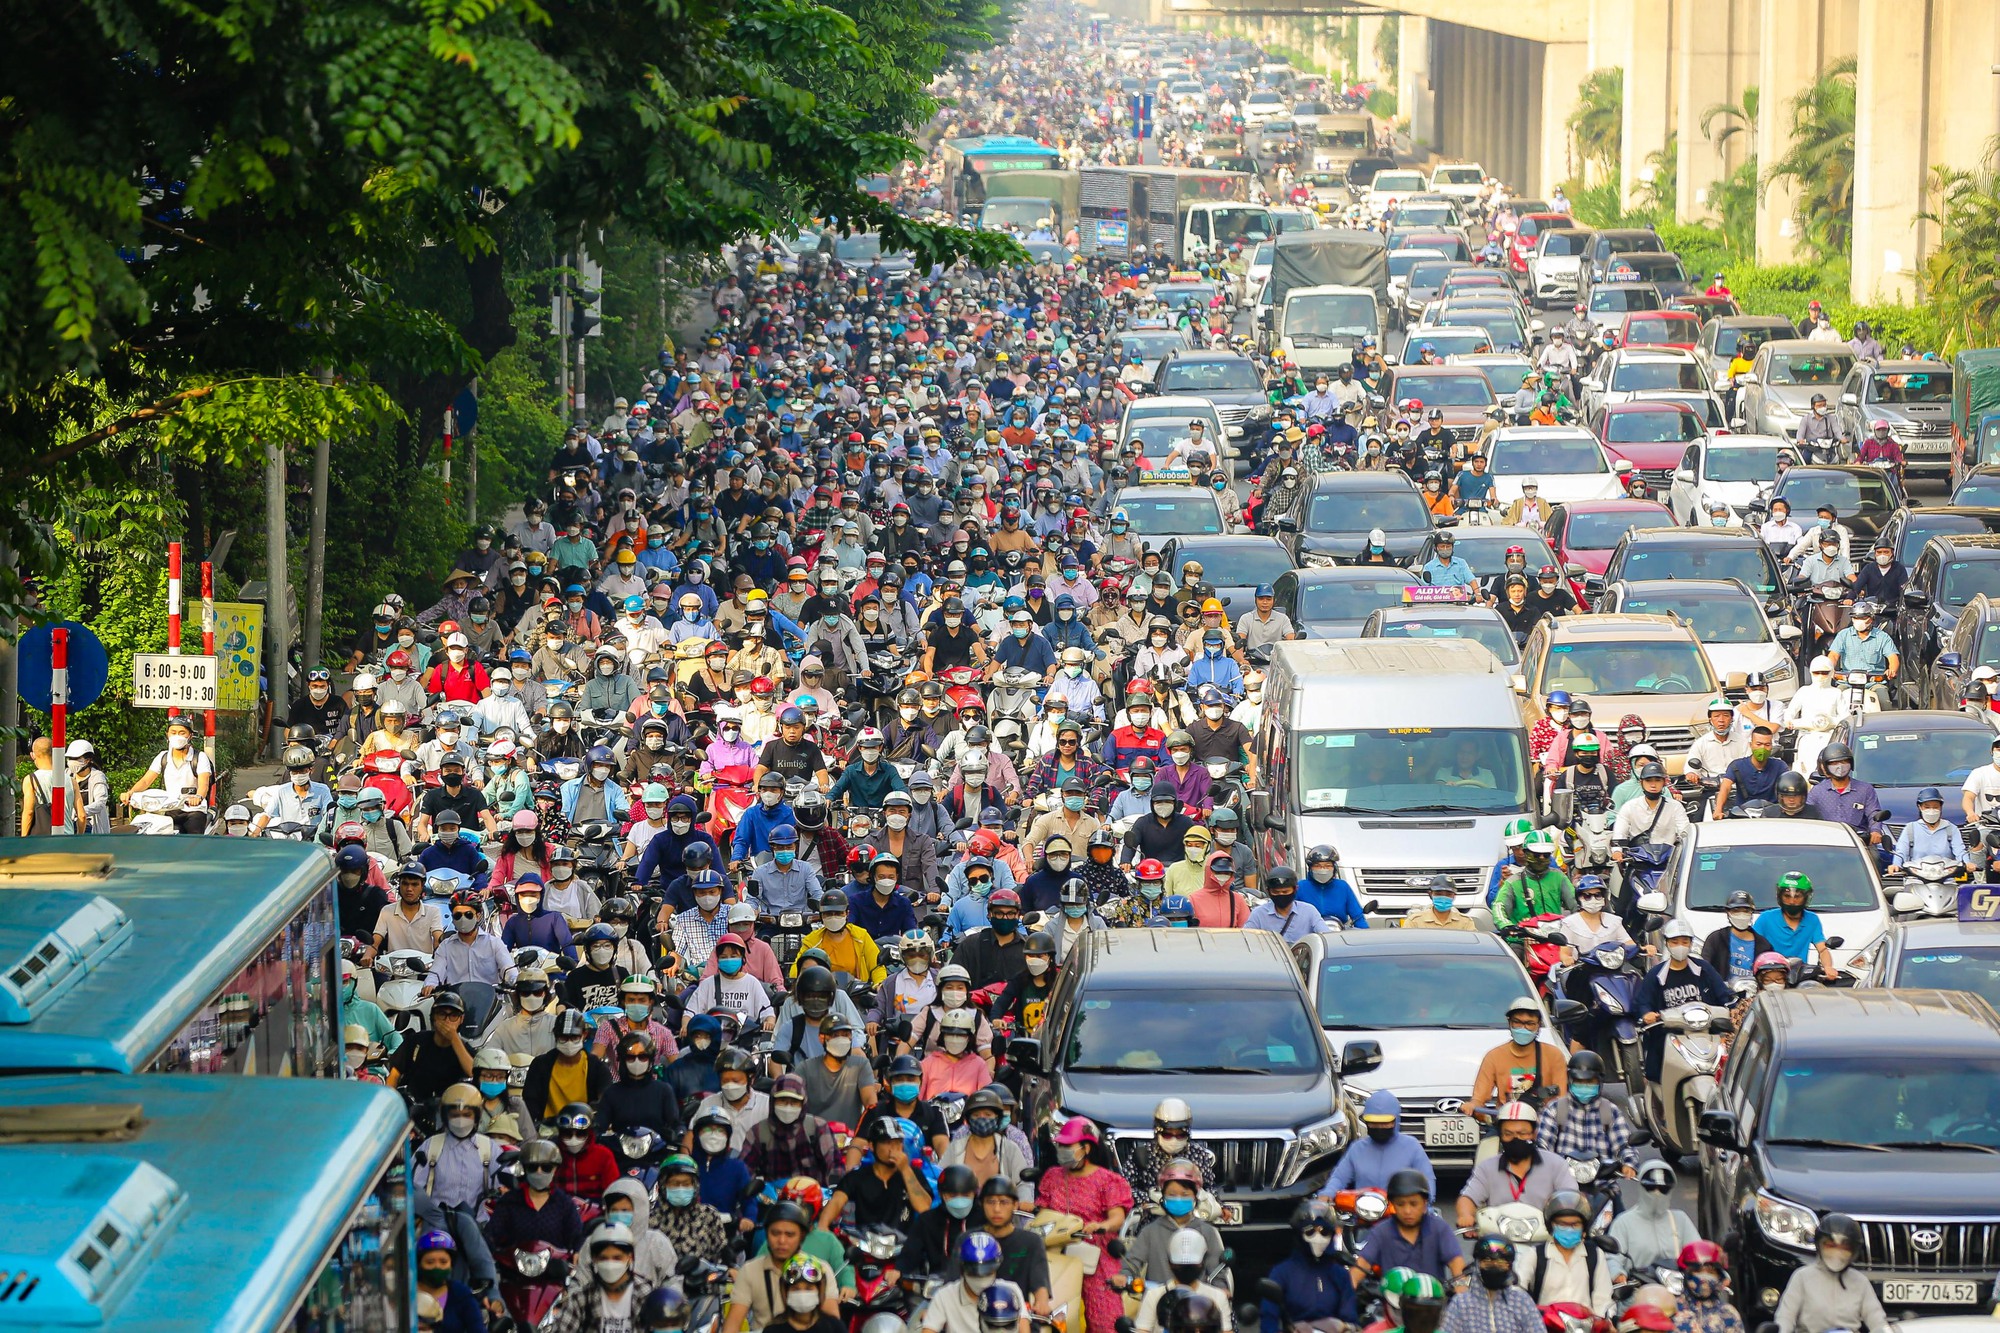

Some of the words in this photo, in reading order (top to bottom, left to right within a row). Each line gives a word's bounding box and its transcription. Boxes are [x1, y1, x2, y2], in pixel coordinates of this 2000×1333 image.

[144, 663, 206, 680] 6:00-9:00
[139, 684, 214, 701] 16:30-19:30
[1971, 889, 2000, 918] G7
[1441, 1120, 1464, 1132] 30G
[1432, 1132, 1475, 1145] 609.06
[1886, 1283, 1975, 1302] 30F-704.52
